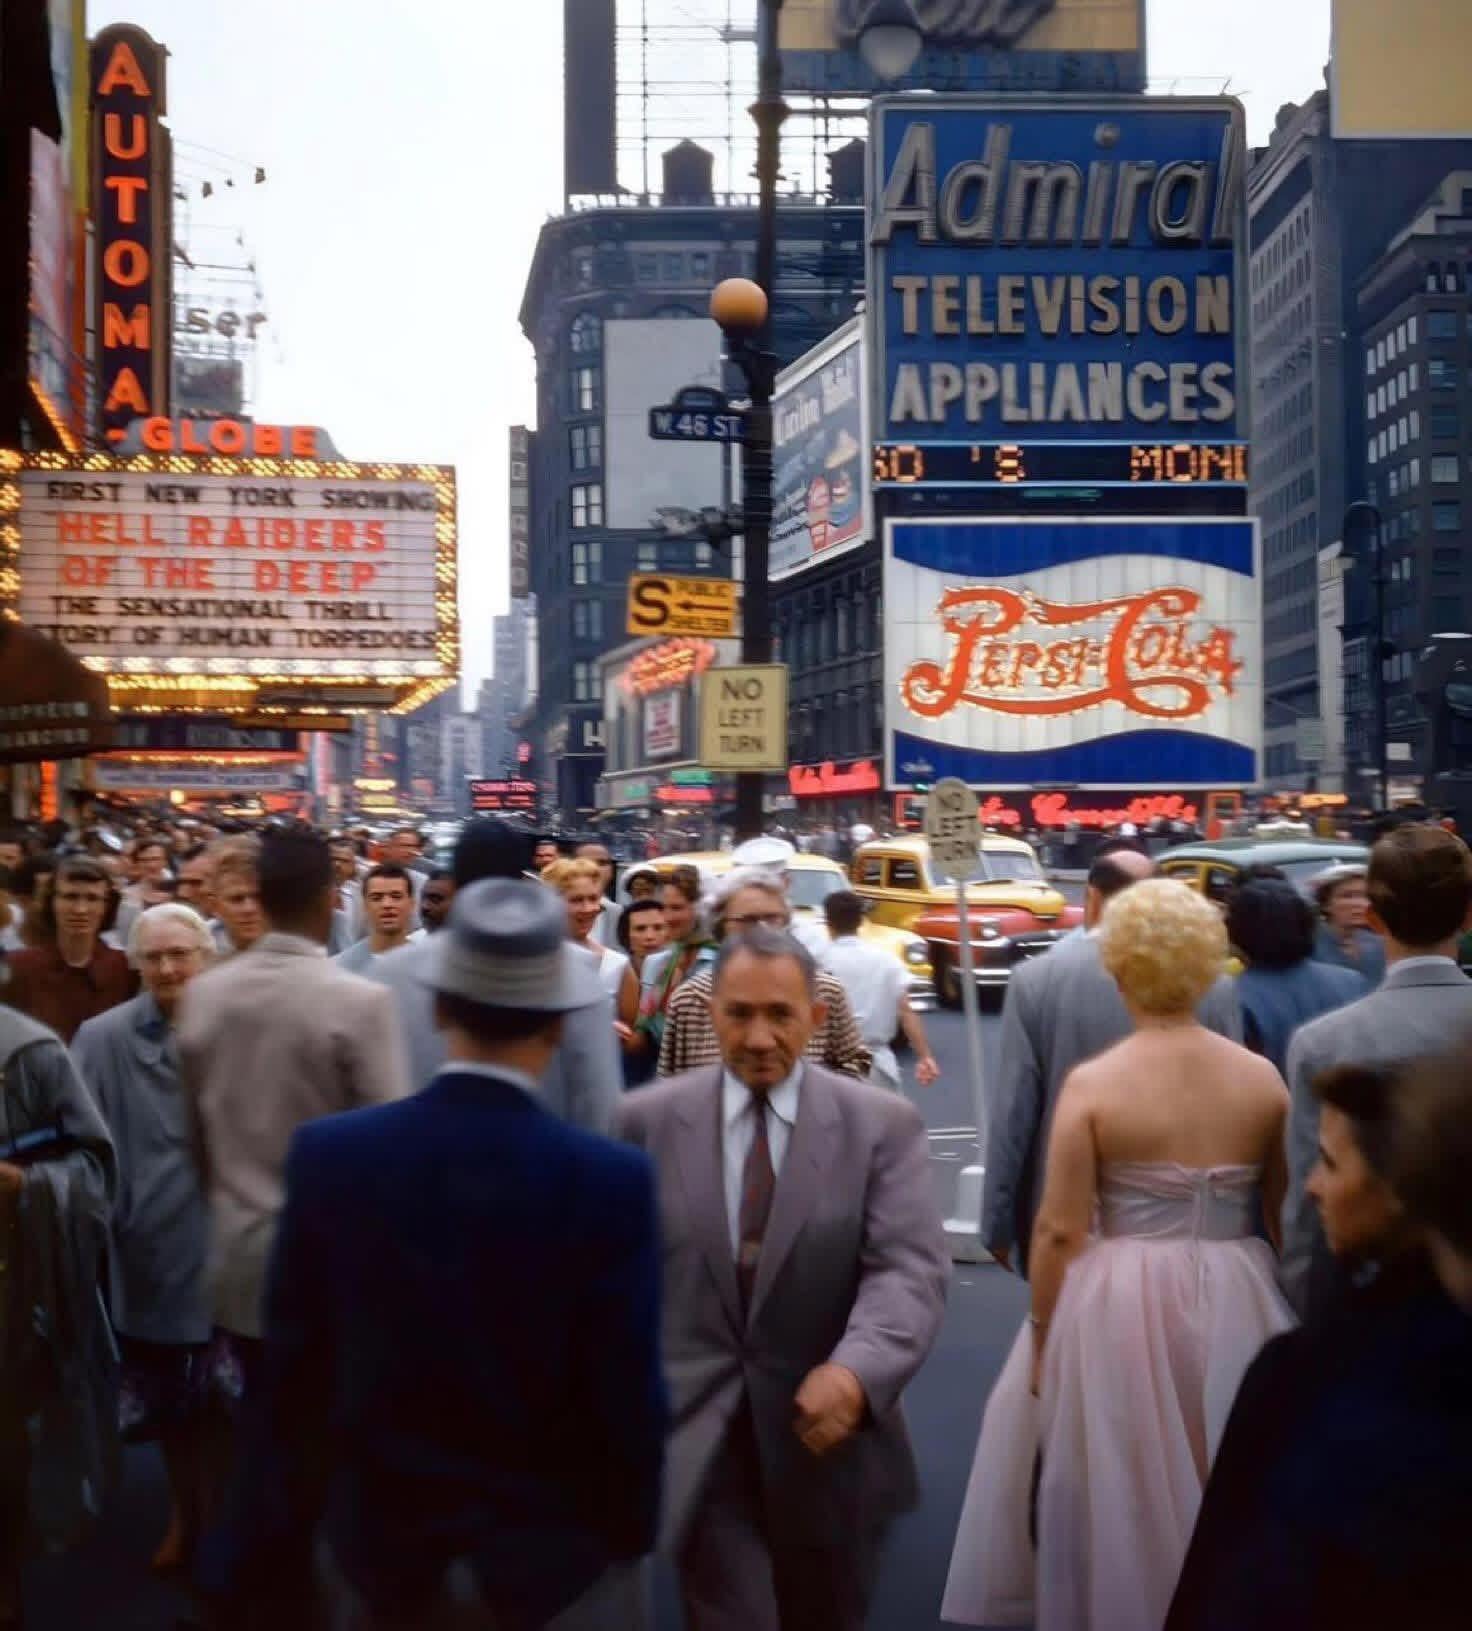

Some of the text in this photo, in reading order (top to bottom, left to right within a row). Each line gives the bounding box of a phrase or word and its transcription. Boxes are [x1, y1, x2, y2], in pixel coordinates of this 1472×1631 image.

[870, 121, 1243, 247] Admiral
[98, 41, 153, 442] AUTOMA
[892, 275, 1231, 336] TELEVISION
[889, 361, 1236, 423] APPLIANCES
[140, 416, 319, 457] GLOBE
[676, 413, 708, 436] 46
[47, 480, 436, 512] FIRST NEW YORK SHOWING
[187, 515, 387, 554] RAIDERS
[60, 554, 118, 588] OF
[136, 556, 215, 592] THE
[50, 594, 392, 621] THE SENSATIONAL THRILL
[632, 580, 670, 627] S
[32, 623, 436, 650] TORY OF HUMAN TORPEDOES
[722, 677, 764, 702] NO
[718, 707, 766, 729] LEFT
[719, 735, 765, 753] TURN
[938, 791, 965, 813] NO
[931, 815, 978, 838] LEFT
